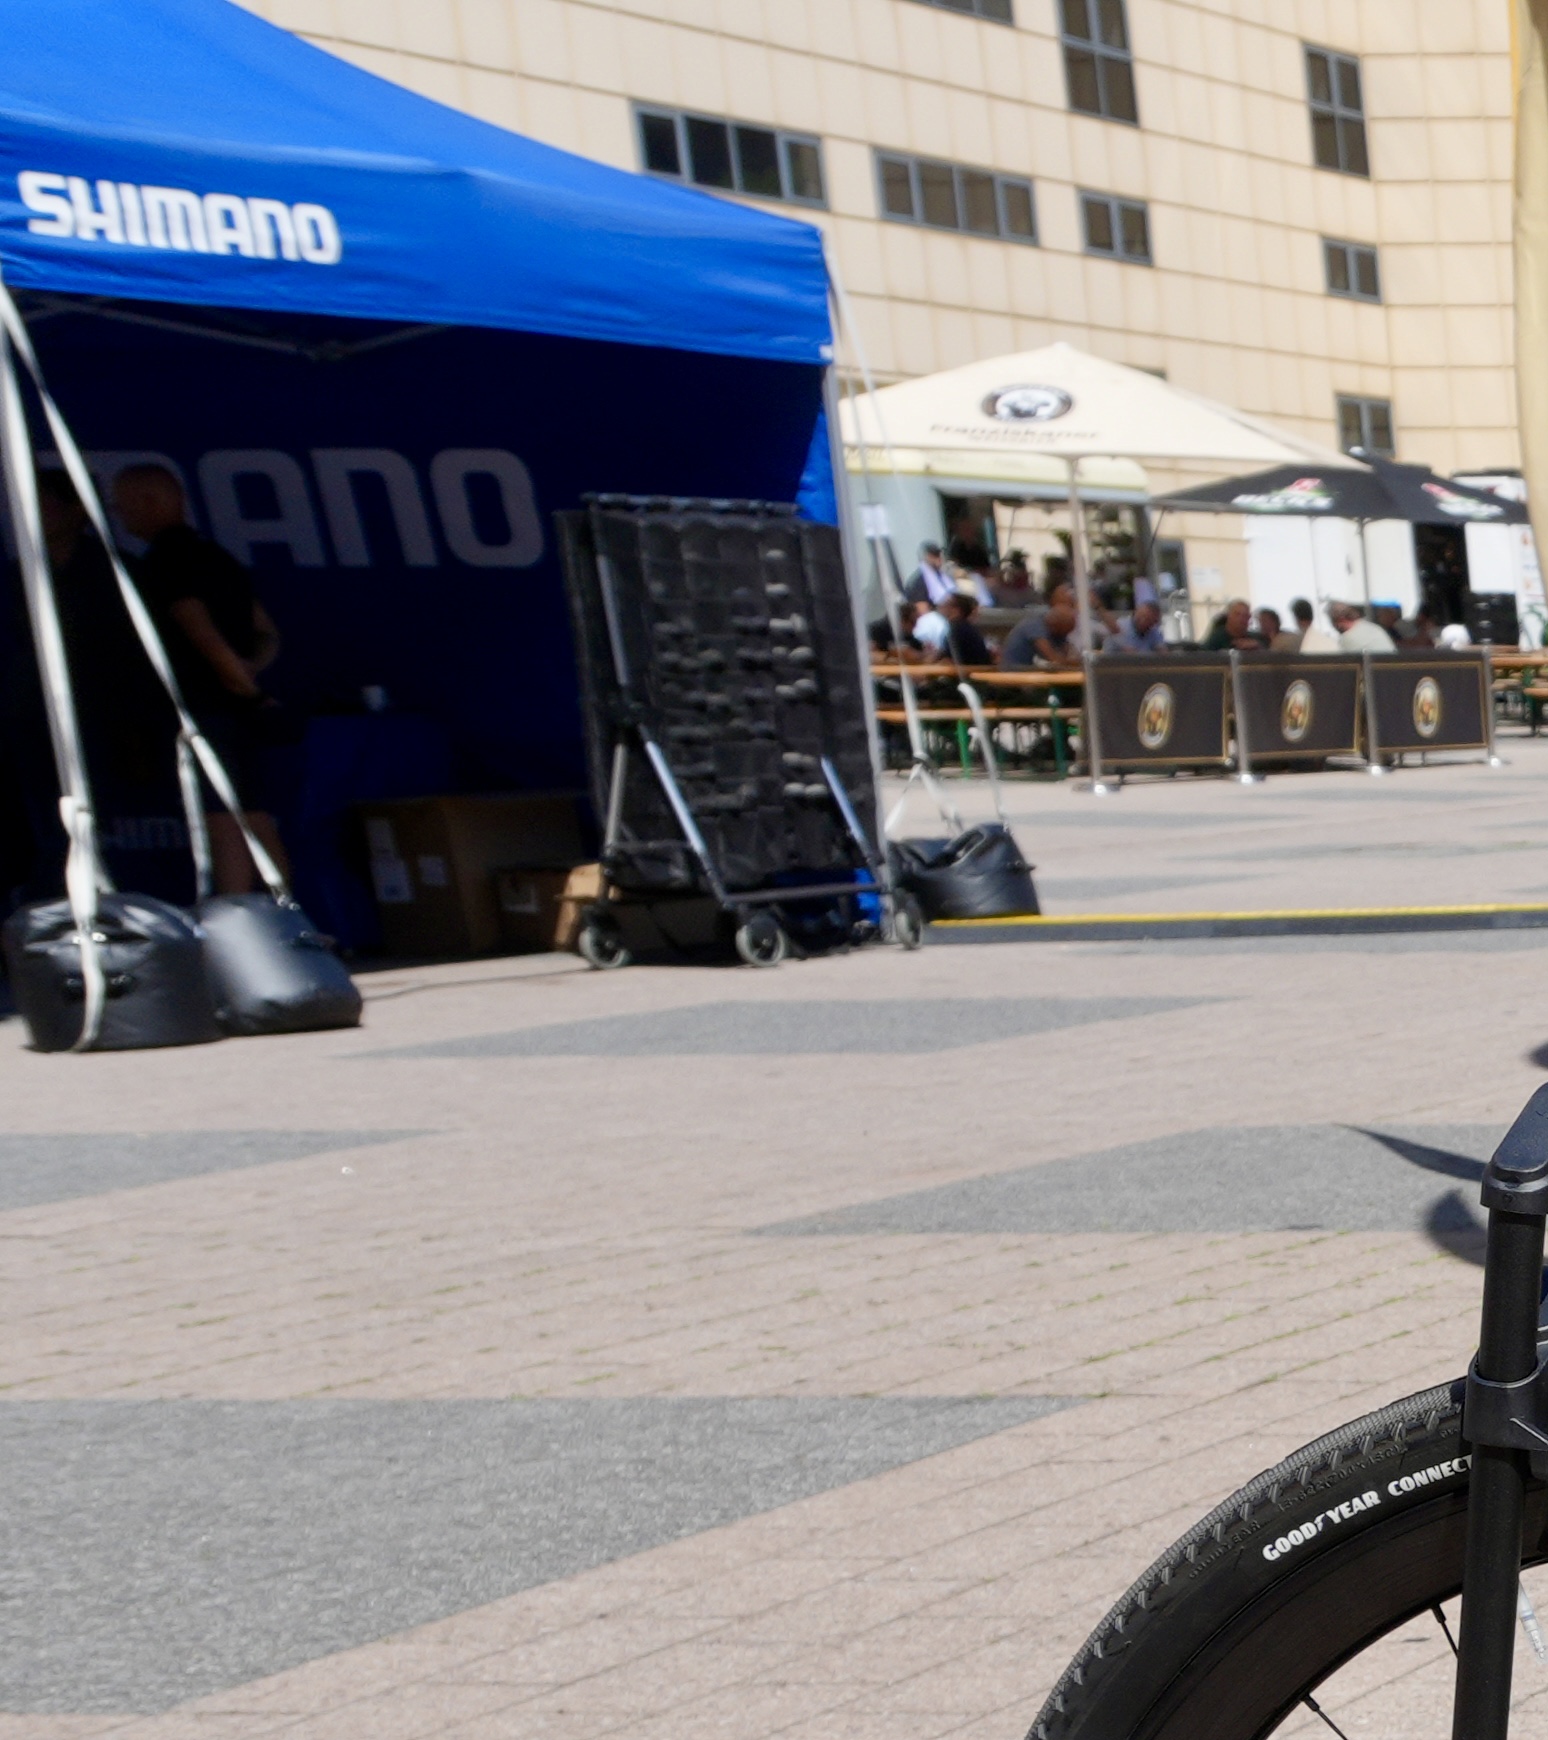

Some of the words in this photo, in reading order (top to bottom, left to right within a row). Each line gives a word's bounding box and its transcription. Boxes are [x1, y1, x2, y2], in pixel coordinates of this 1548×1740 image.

[18, 170, 341, 266] SHIMANO
[38, 448, 543, 569] ANO
[1262, 1490, 1381, 1561] GOODYEAR
